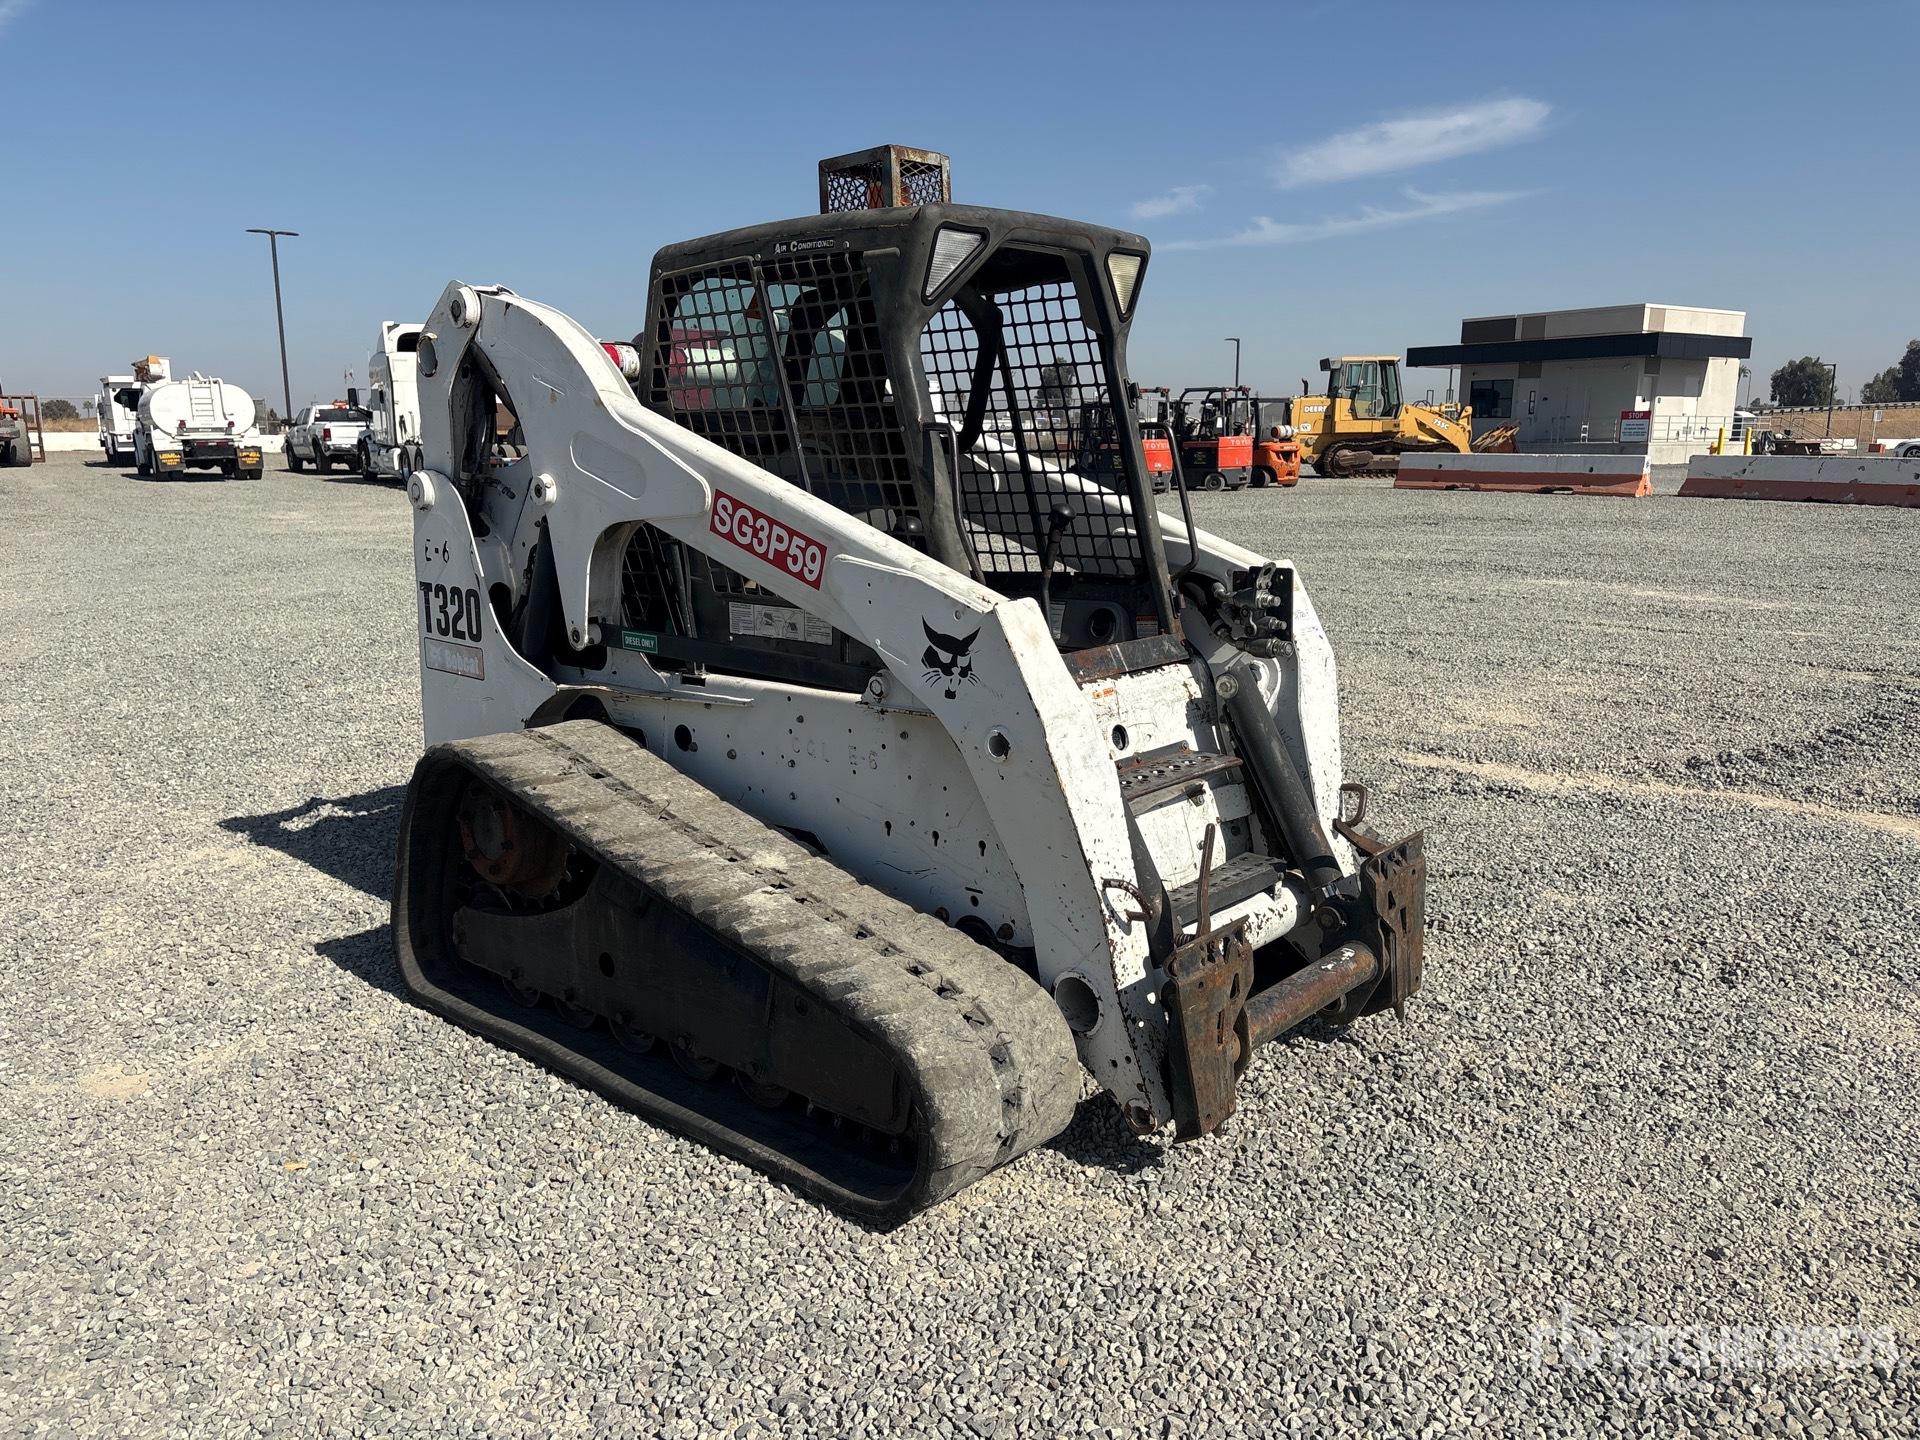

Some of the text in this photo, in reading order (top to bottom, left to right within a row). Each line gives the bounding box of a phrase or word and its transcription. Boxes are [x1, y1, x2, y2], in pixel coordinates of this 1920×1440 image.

[1433, 418, 1450, 430] 755C
[713, 496, 822, 582] SG3P59
[419, 581, 483, 643] T320
[624, 635, 655, 648] DIESEL ONLY
[444, 648, 480, 675] Bobcat
